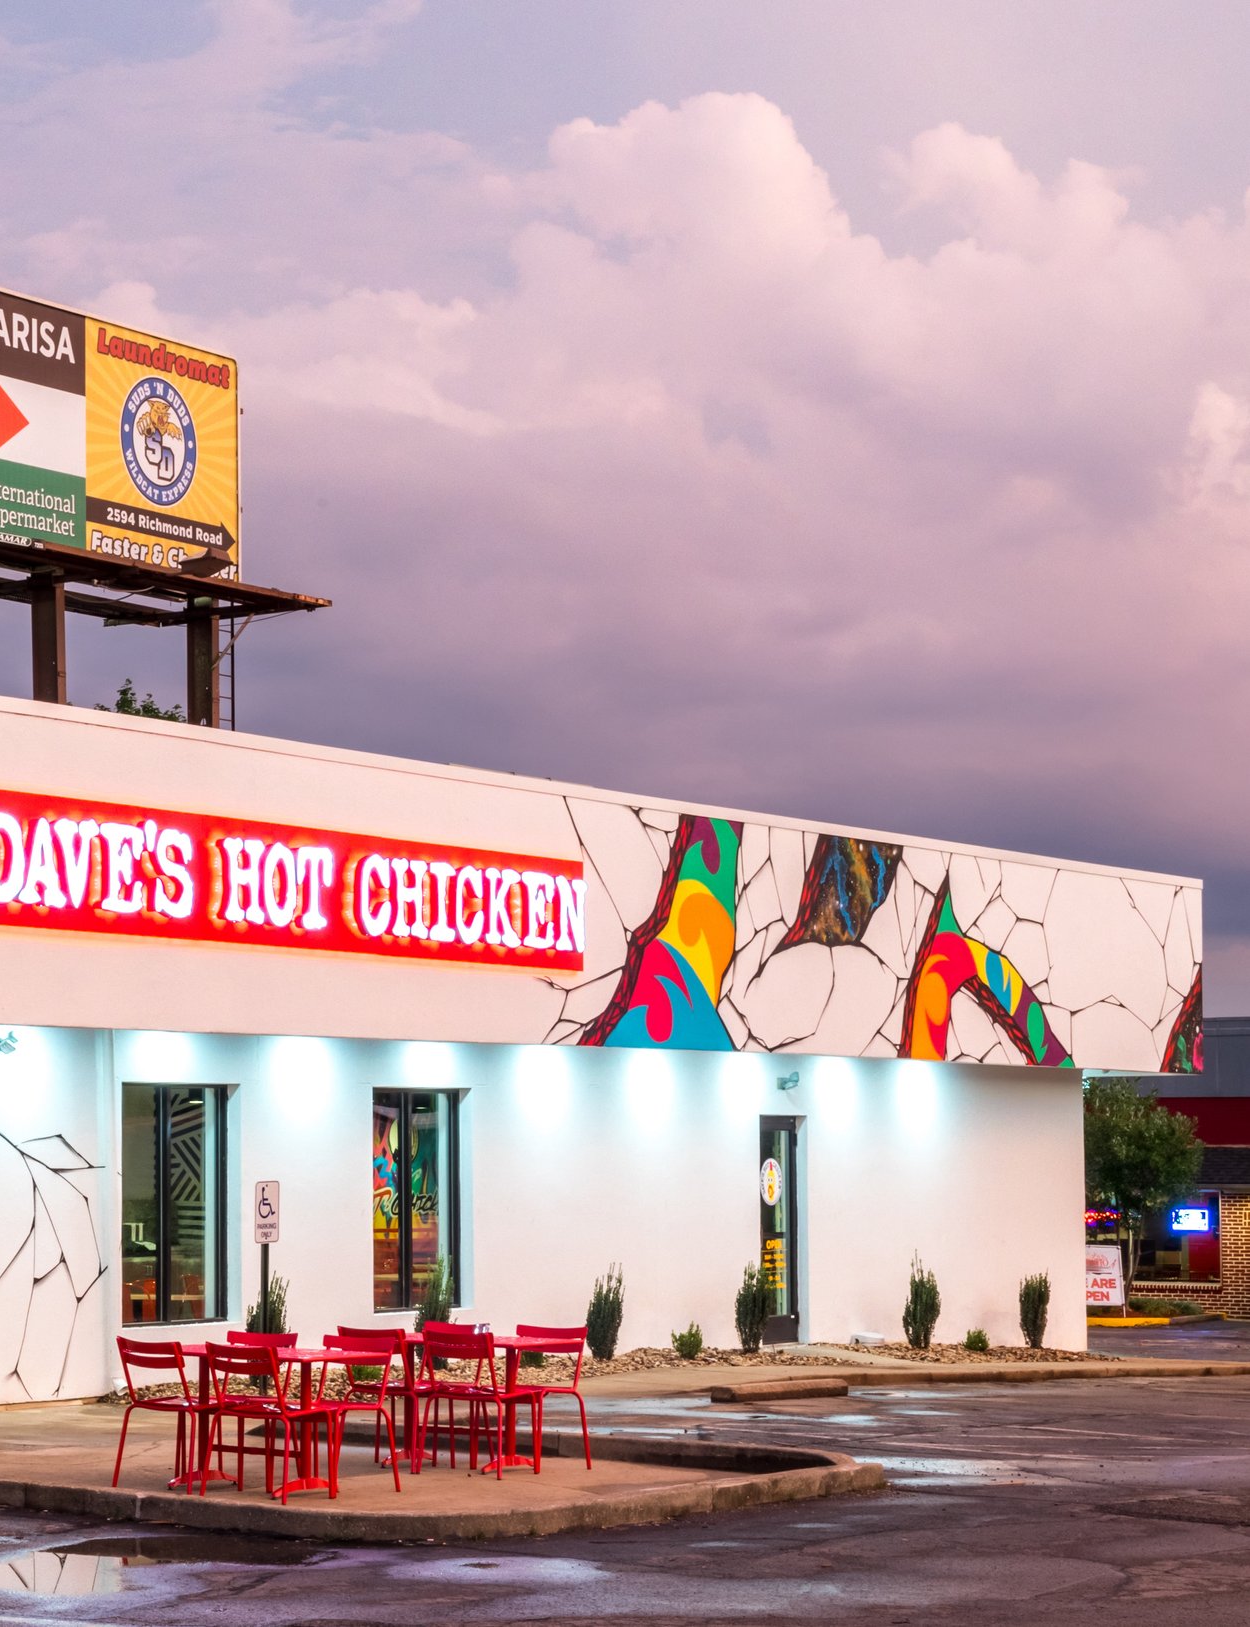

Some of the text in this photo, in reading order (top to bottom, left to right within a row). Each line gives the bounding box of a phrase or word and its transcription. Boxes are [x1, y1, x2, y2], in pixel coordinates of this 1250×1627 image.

[97, 327, 231, 389] Laundromat
[128, 383, 151, 414] SUDS
[166, 391, 190, 426] DUDS
[125, 448, 193, 502] WILDCAT EXPRESS
[106, 507, 223, 546] 2594 Richmond Road
[91, 529, 238, 581] Faster & Cher
[223, 837, 334, 931] HOT
[359, 855, 588, 955] CHICKEN
[256, 1222, 277, 1230] PARKING
[1086, 1290, 1110, 1302] PEN
[1091, 1278, 1116, 1289] ARE
